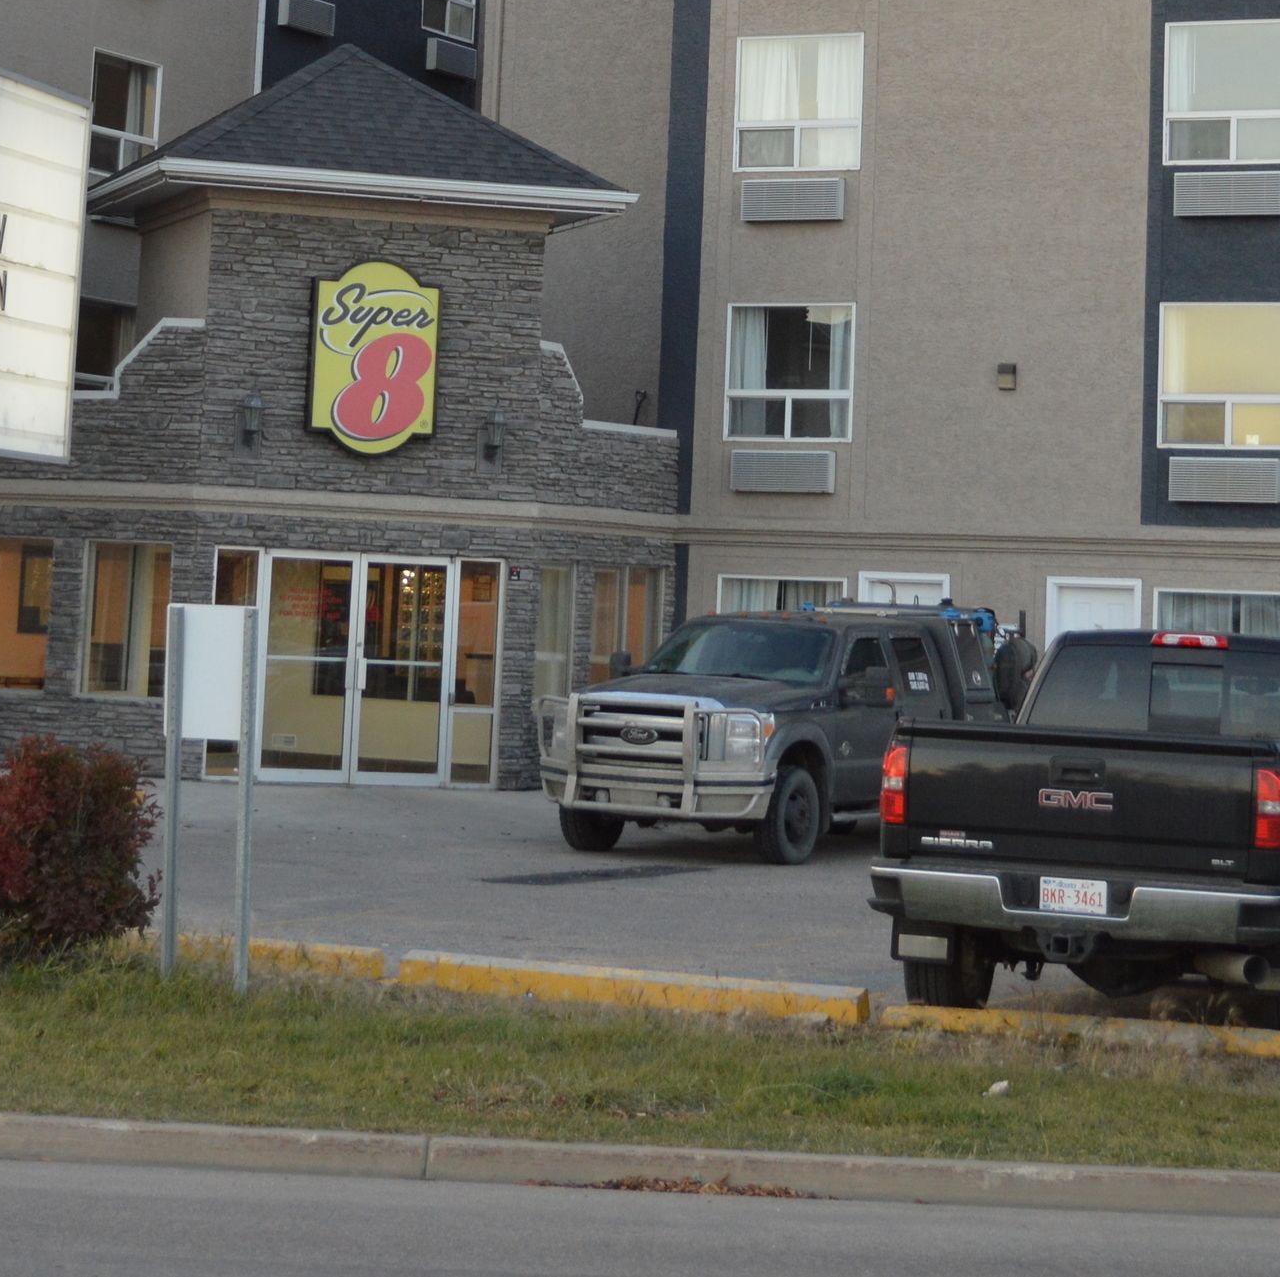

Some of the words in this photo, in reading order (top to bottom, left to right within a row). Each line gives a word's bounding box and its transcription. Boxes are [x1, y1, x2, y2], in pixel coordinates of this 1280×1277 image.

[321, 282, 436, 349] Super
[330, 332, 433, 442] 8
[627, 727, 649, 741] Ford
[1038, 788, 1114, 811] GMC
[921, 836, 993, 850] SIERRA
[1042, 887, 1103, 908] BKR-3461
